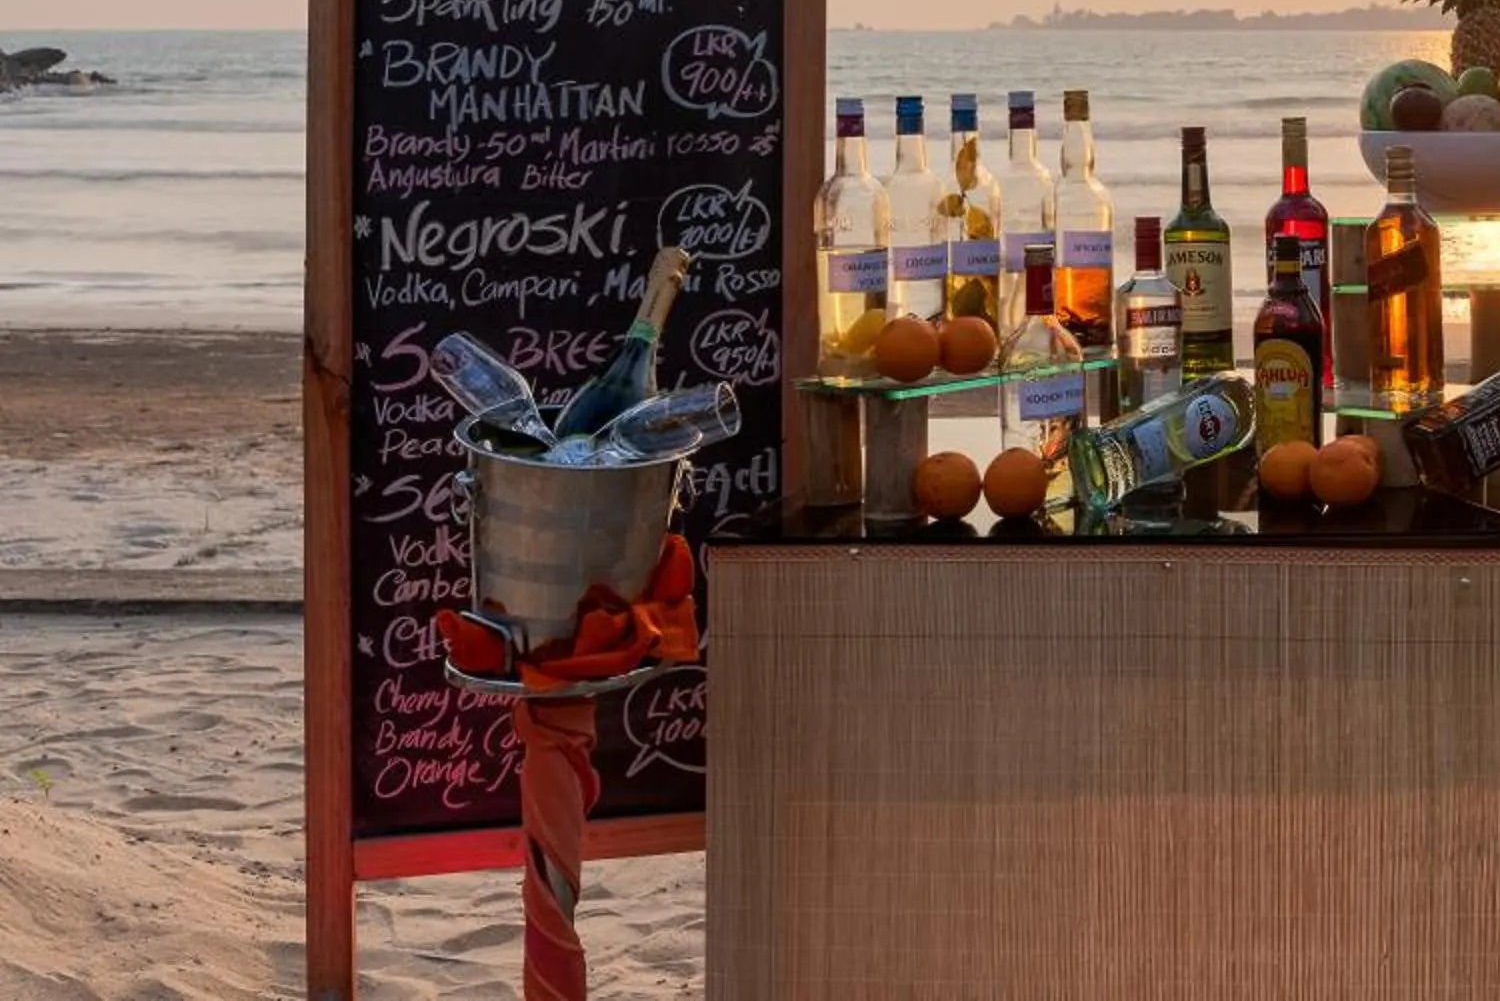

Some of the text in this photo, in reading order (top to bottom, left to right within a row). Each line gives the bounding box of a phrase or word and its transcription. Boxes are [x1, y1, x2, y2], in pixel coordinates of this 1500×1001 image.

[382, 40, 556, 87] BRANDY
[693, 33, 736, 58] LKR
[430, 81, 645, 132] MANHATTAN
[559, 125, 656, 165] Martini
[677, 193, 728, 221] LKR
[715, 263, 780, 302] Rosso
[506, 327, 664, 375] BREE
[701, 321, 750, 348] LKR
[373, 394, 456, 426] Vodka
[375, 756, 487, 808] Orange
